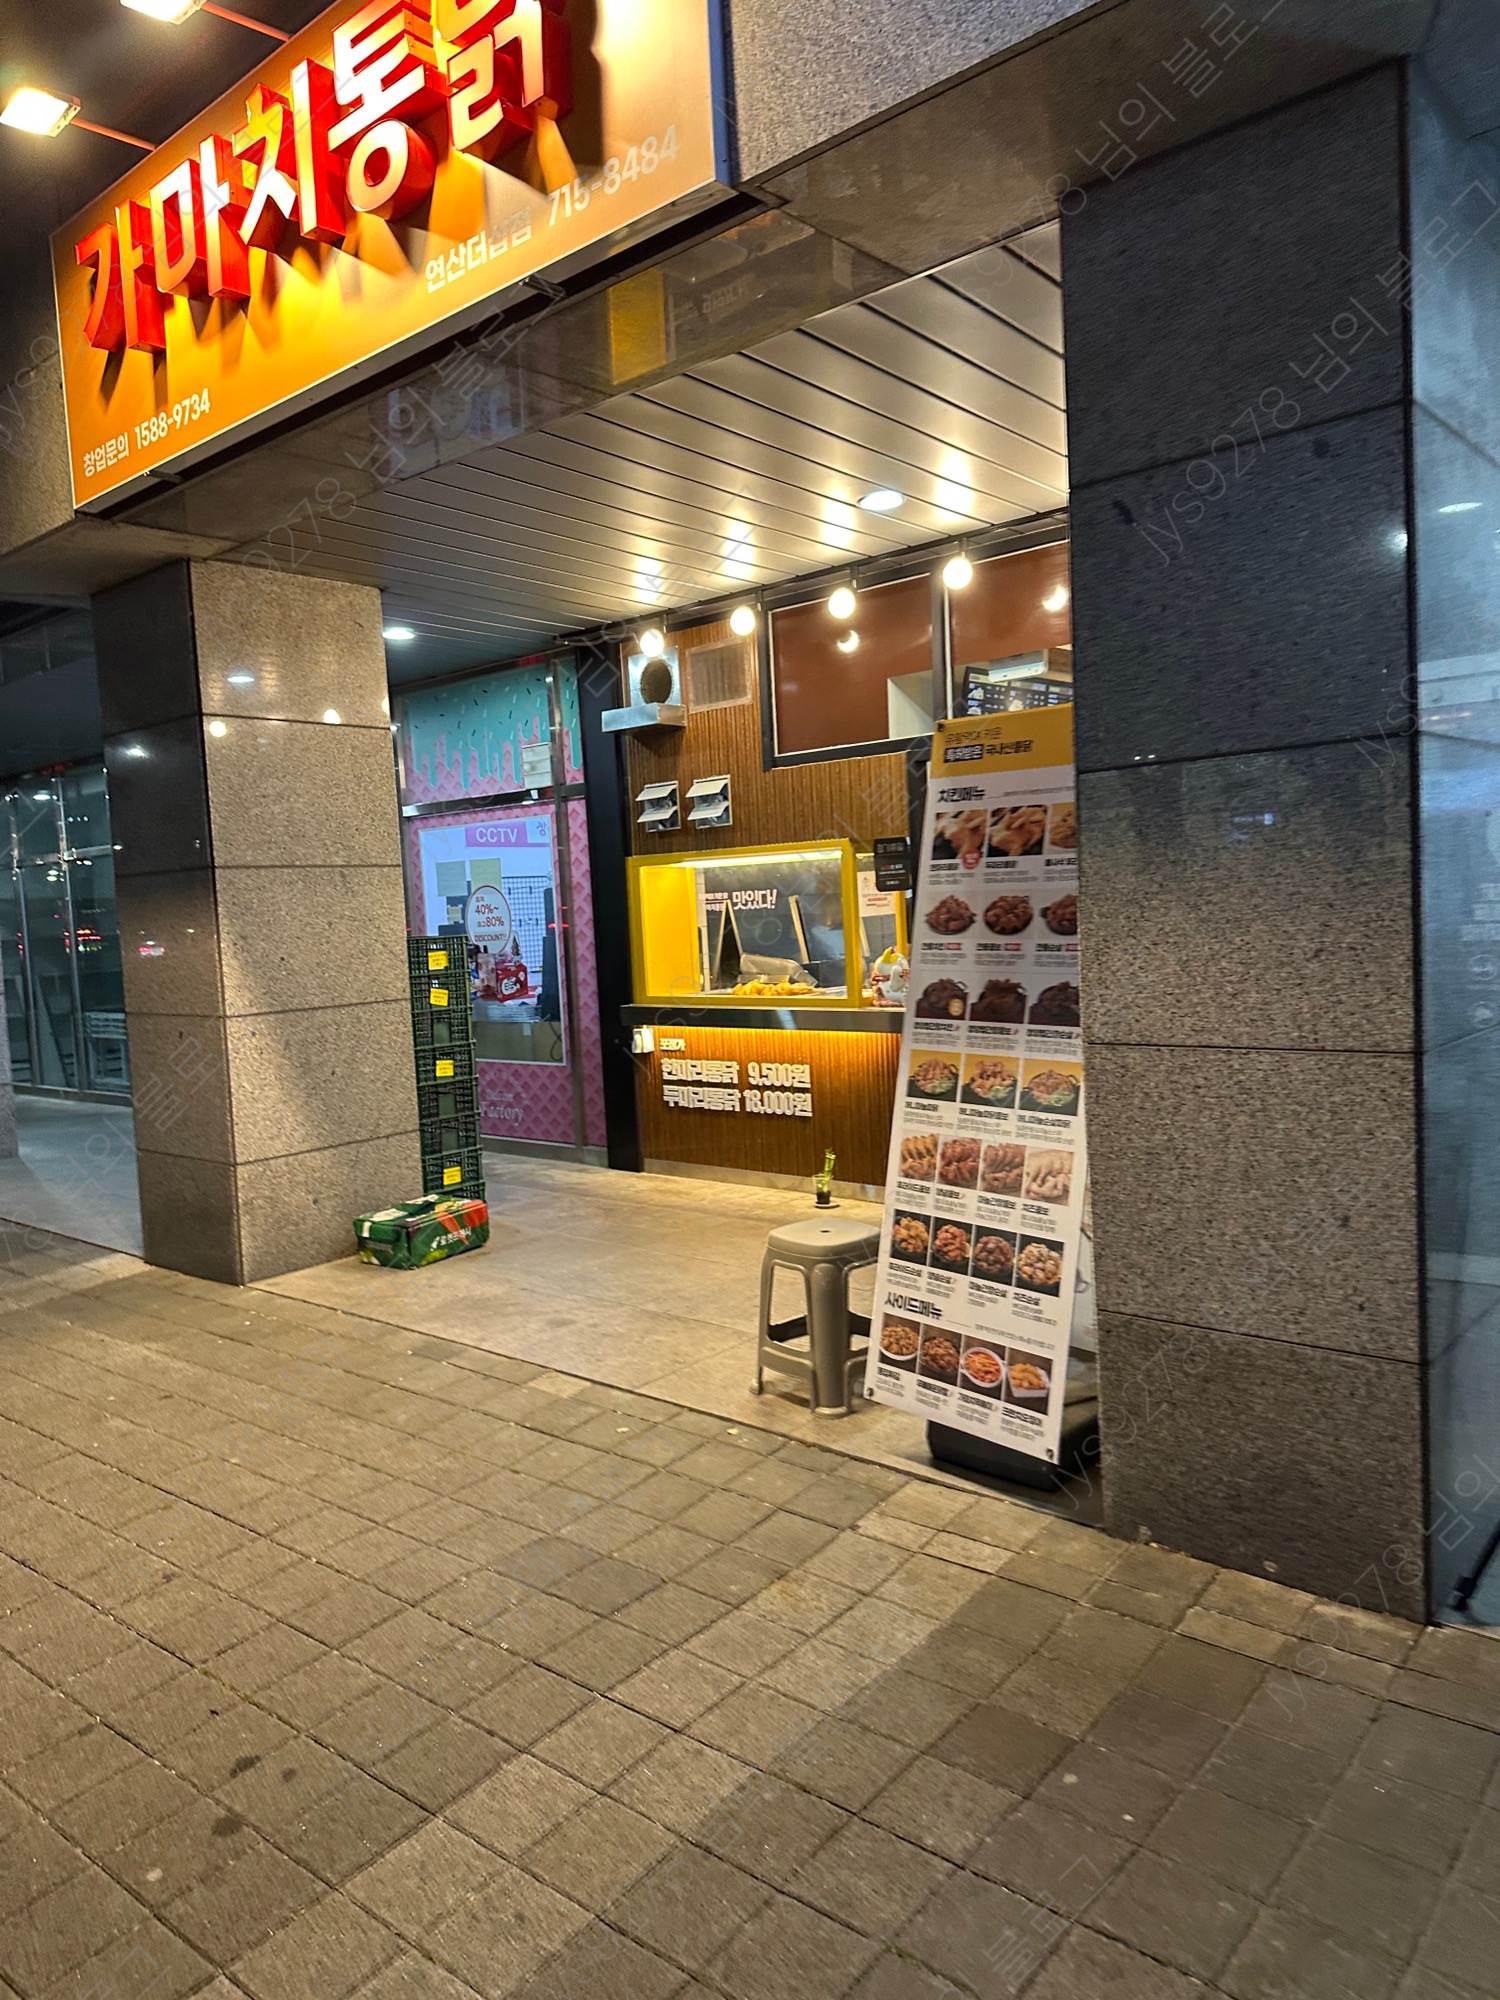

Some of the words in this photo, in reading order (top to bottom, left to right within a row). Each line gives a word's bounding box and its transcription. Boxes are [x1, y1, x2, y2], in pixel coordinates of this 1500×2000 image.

[547, 124, 680, 228] 715-8484
[83, 432, 129, 477] 창업문의
[134, 387, 211, 450] 1588-9734
[938, 786, 985, 802] 치킨메뉴
[475, 827, 518, 843] CCTV
[732, 889, 777, 911] 맛있다!
[661, 1058, 739, 1084] 한마리통닭
[663, 1085, 741, 1112] 두마리통닭
[885, 1291, 943, 1319] 사이드메뉴
